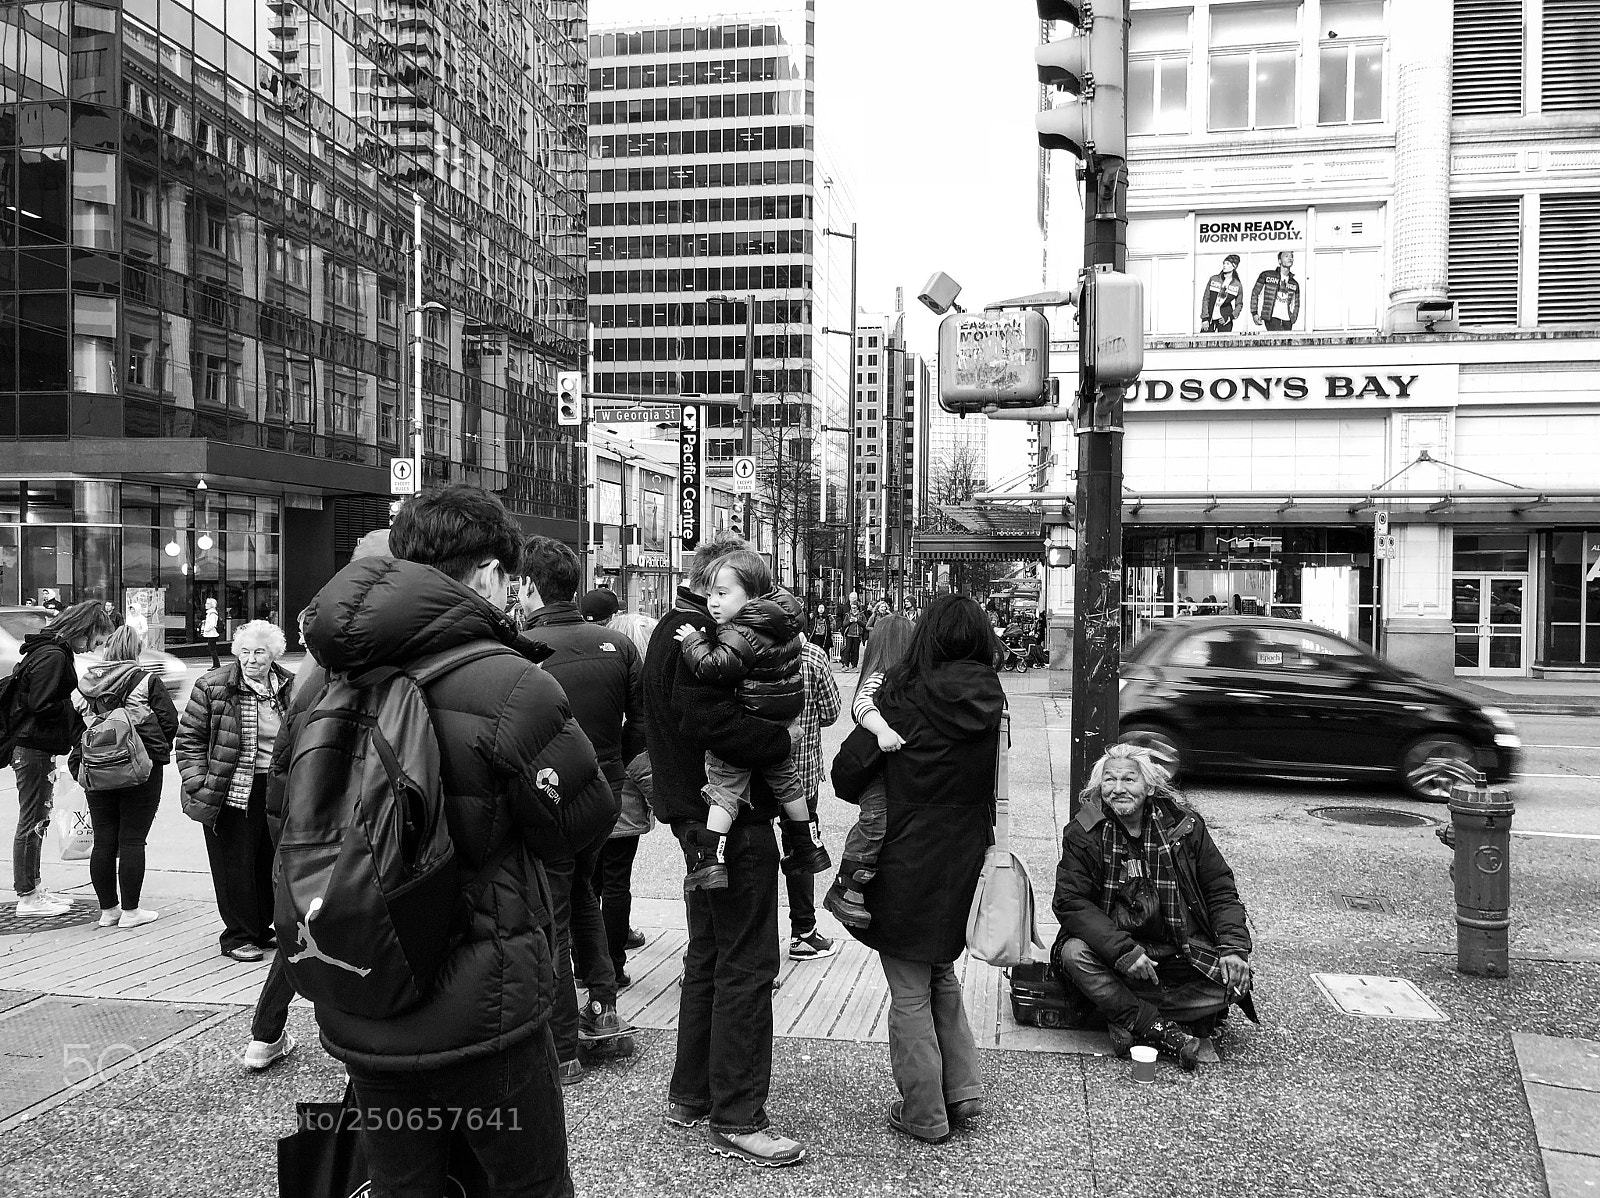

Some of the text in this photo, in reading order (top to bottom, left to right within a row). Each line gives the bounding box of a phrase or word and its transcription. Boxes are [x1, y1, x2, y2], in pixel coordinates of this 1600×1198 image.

[1200, 220, 1294, 233] BORN READY.
[1200, 230, 1303, 243] WORN PROUDLY.
[1124, 375, 1419, 402] UDSON'S BAY
[601, 409, 675, 422] W Georgia St
[683, 434, 697, 484] Pacific
[682, 487, 697, 540] Centre
